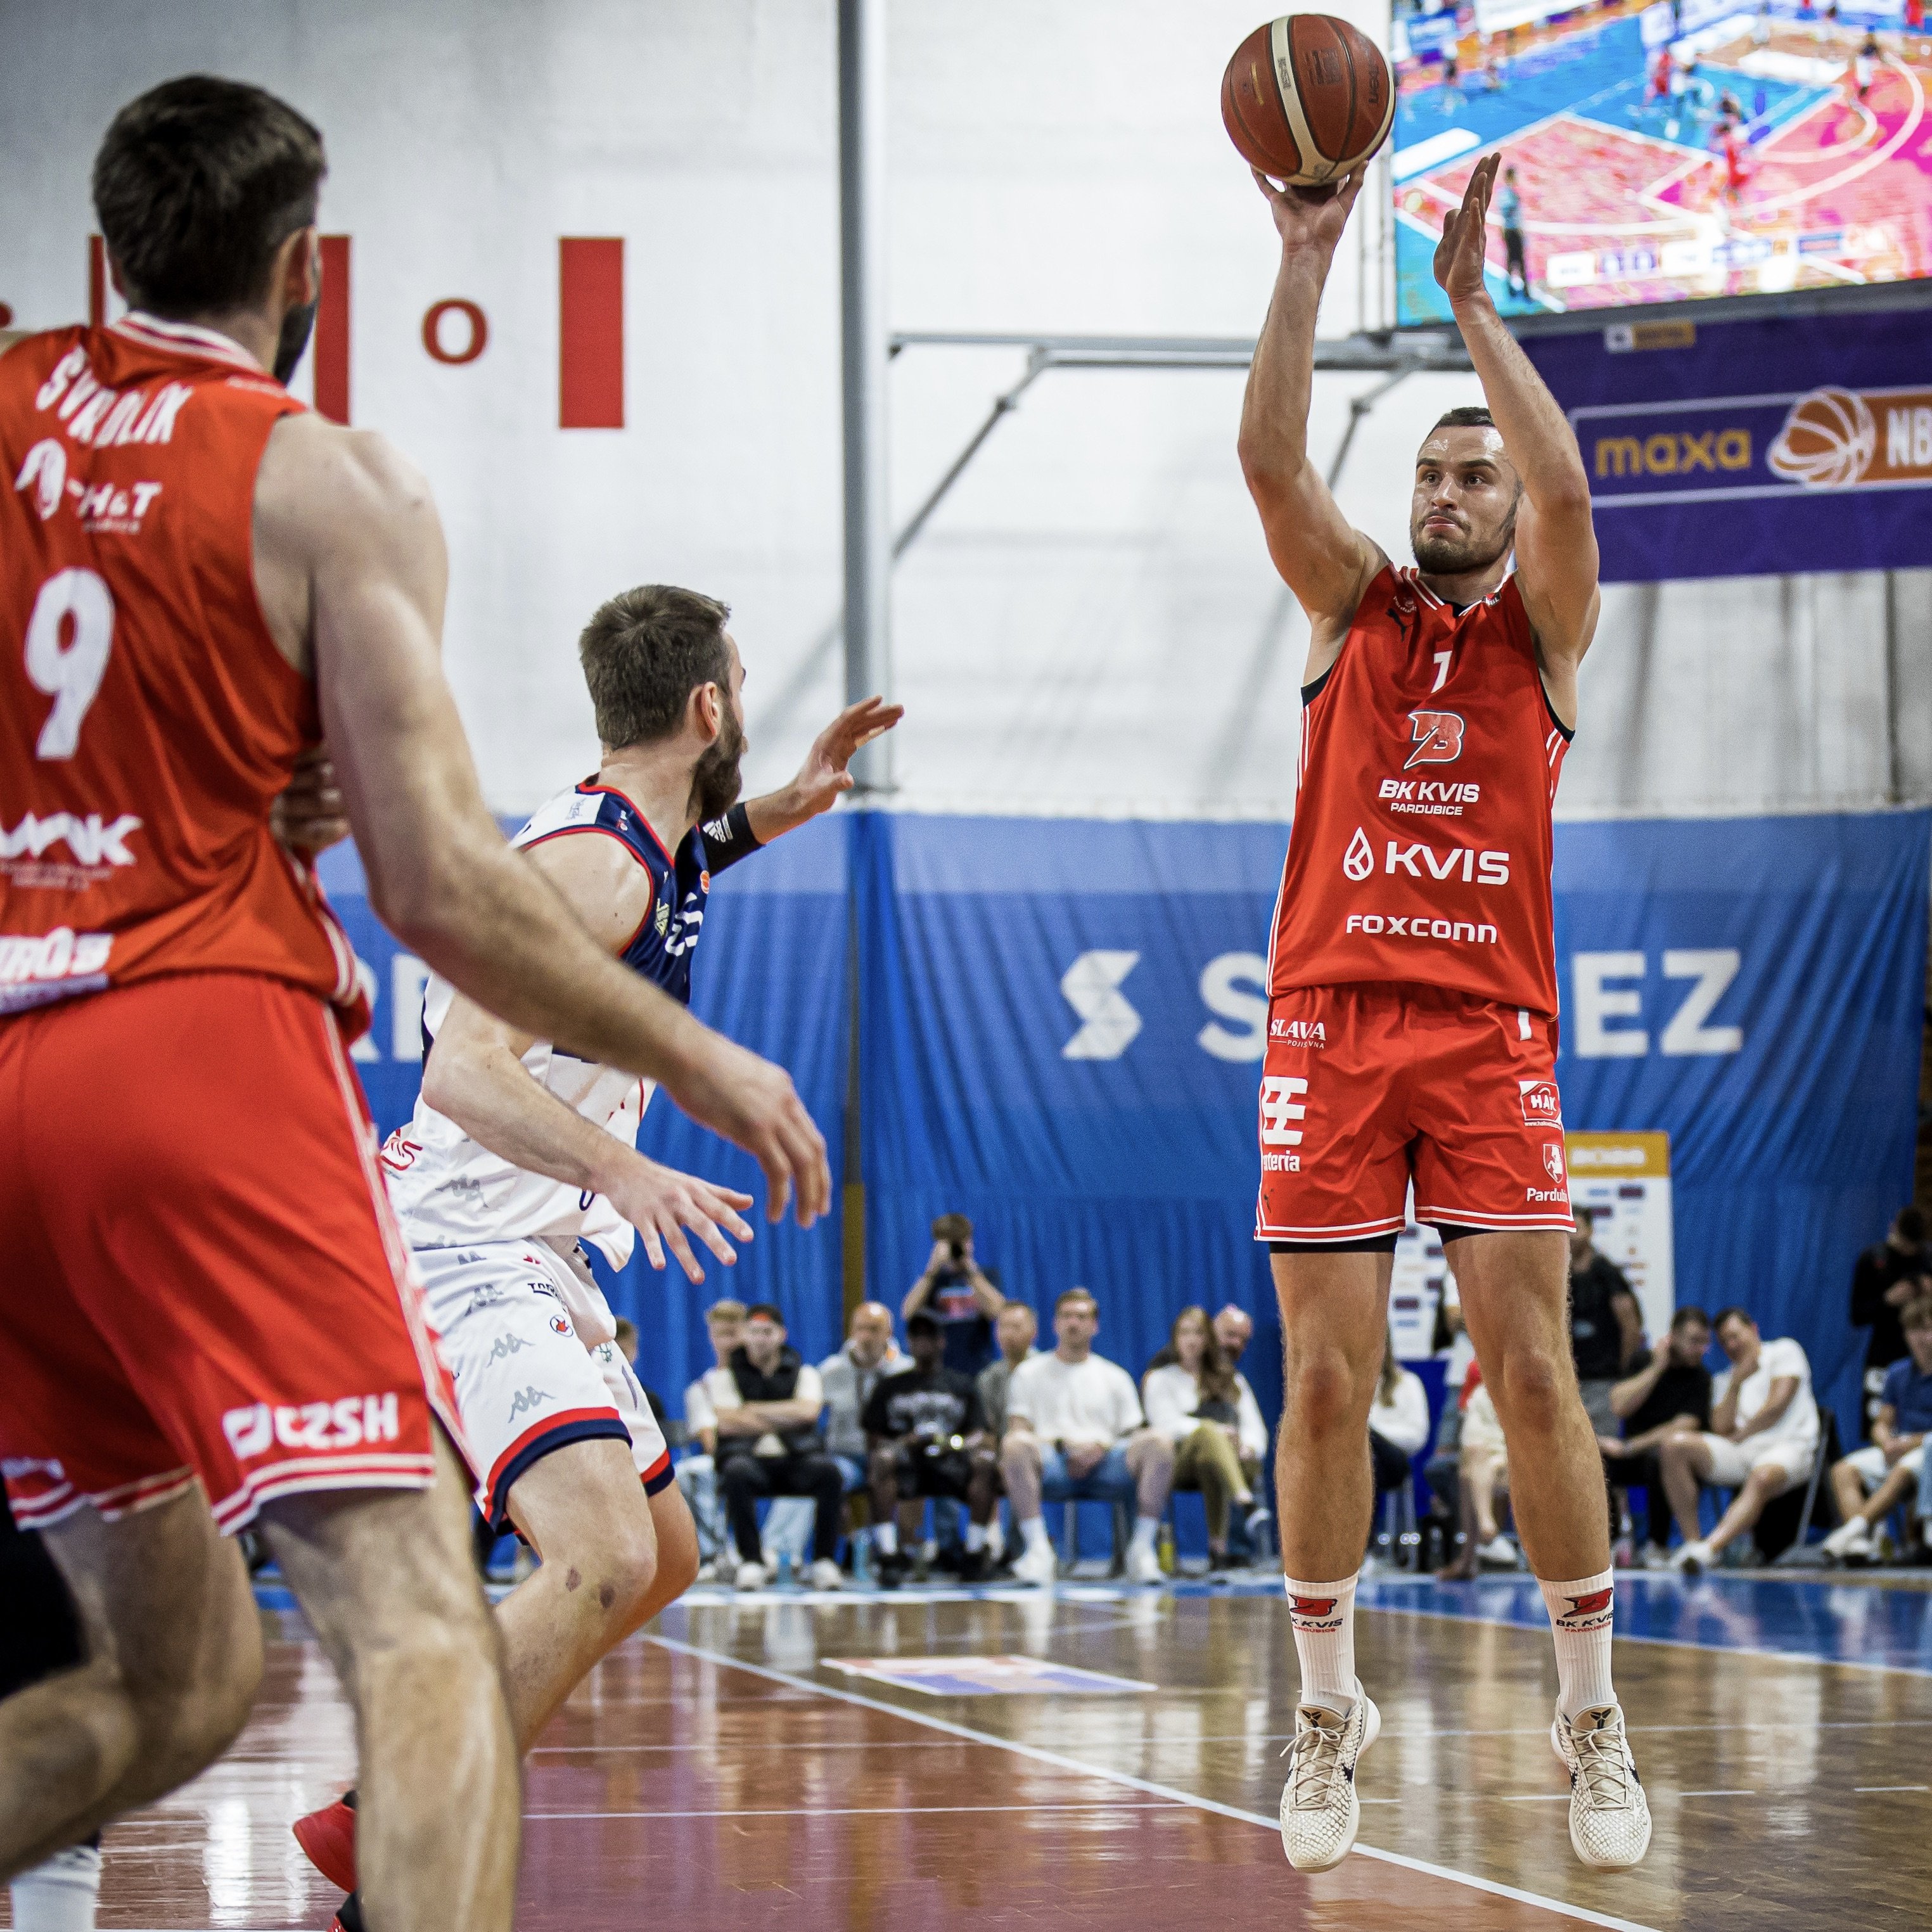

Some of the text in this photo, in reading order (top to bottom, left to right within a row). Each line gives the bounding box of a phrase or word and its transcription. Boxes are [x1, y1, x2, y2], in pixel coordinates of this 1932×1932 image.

[1594, 428, 1753, 478] maxa
[23, 568, 115, 759] 9
[1378, 779, 1480, 803] BK KVIS
[1390, 802, 1464, 816] PARDUBICE
[1385, 841, 1510, 885] KVIS
[1530, 1094, 1558, 1112] HAK
[1302, 1618, 1343, 1628] KVIS
[1556, 1618, 1578, 1628] BK
